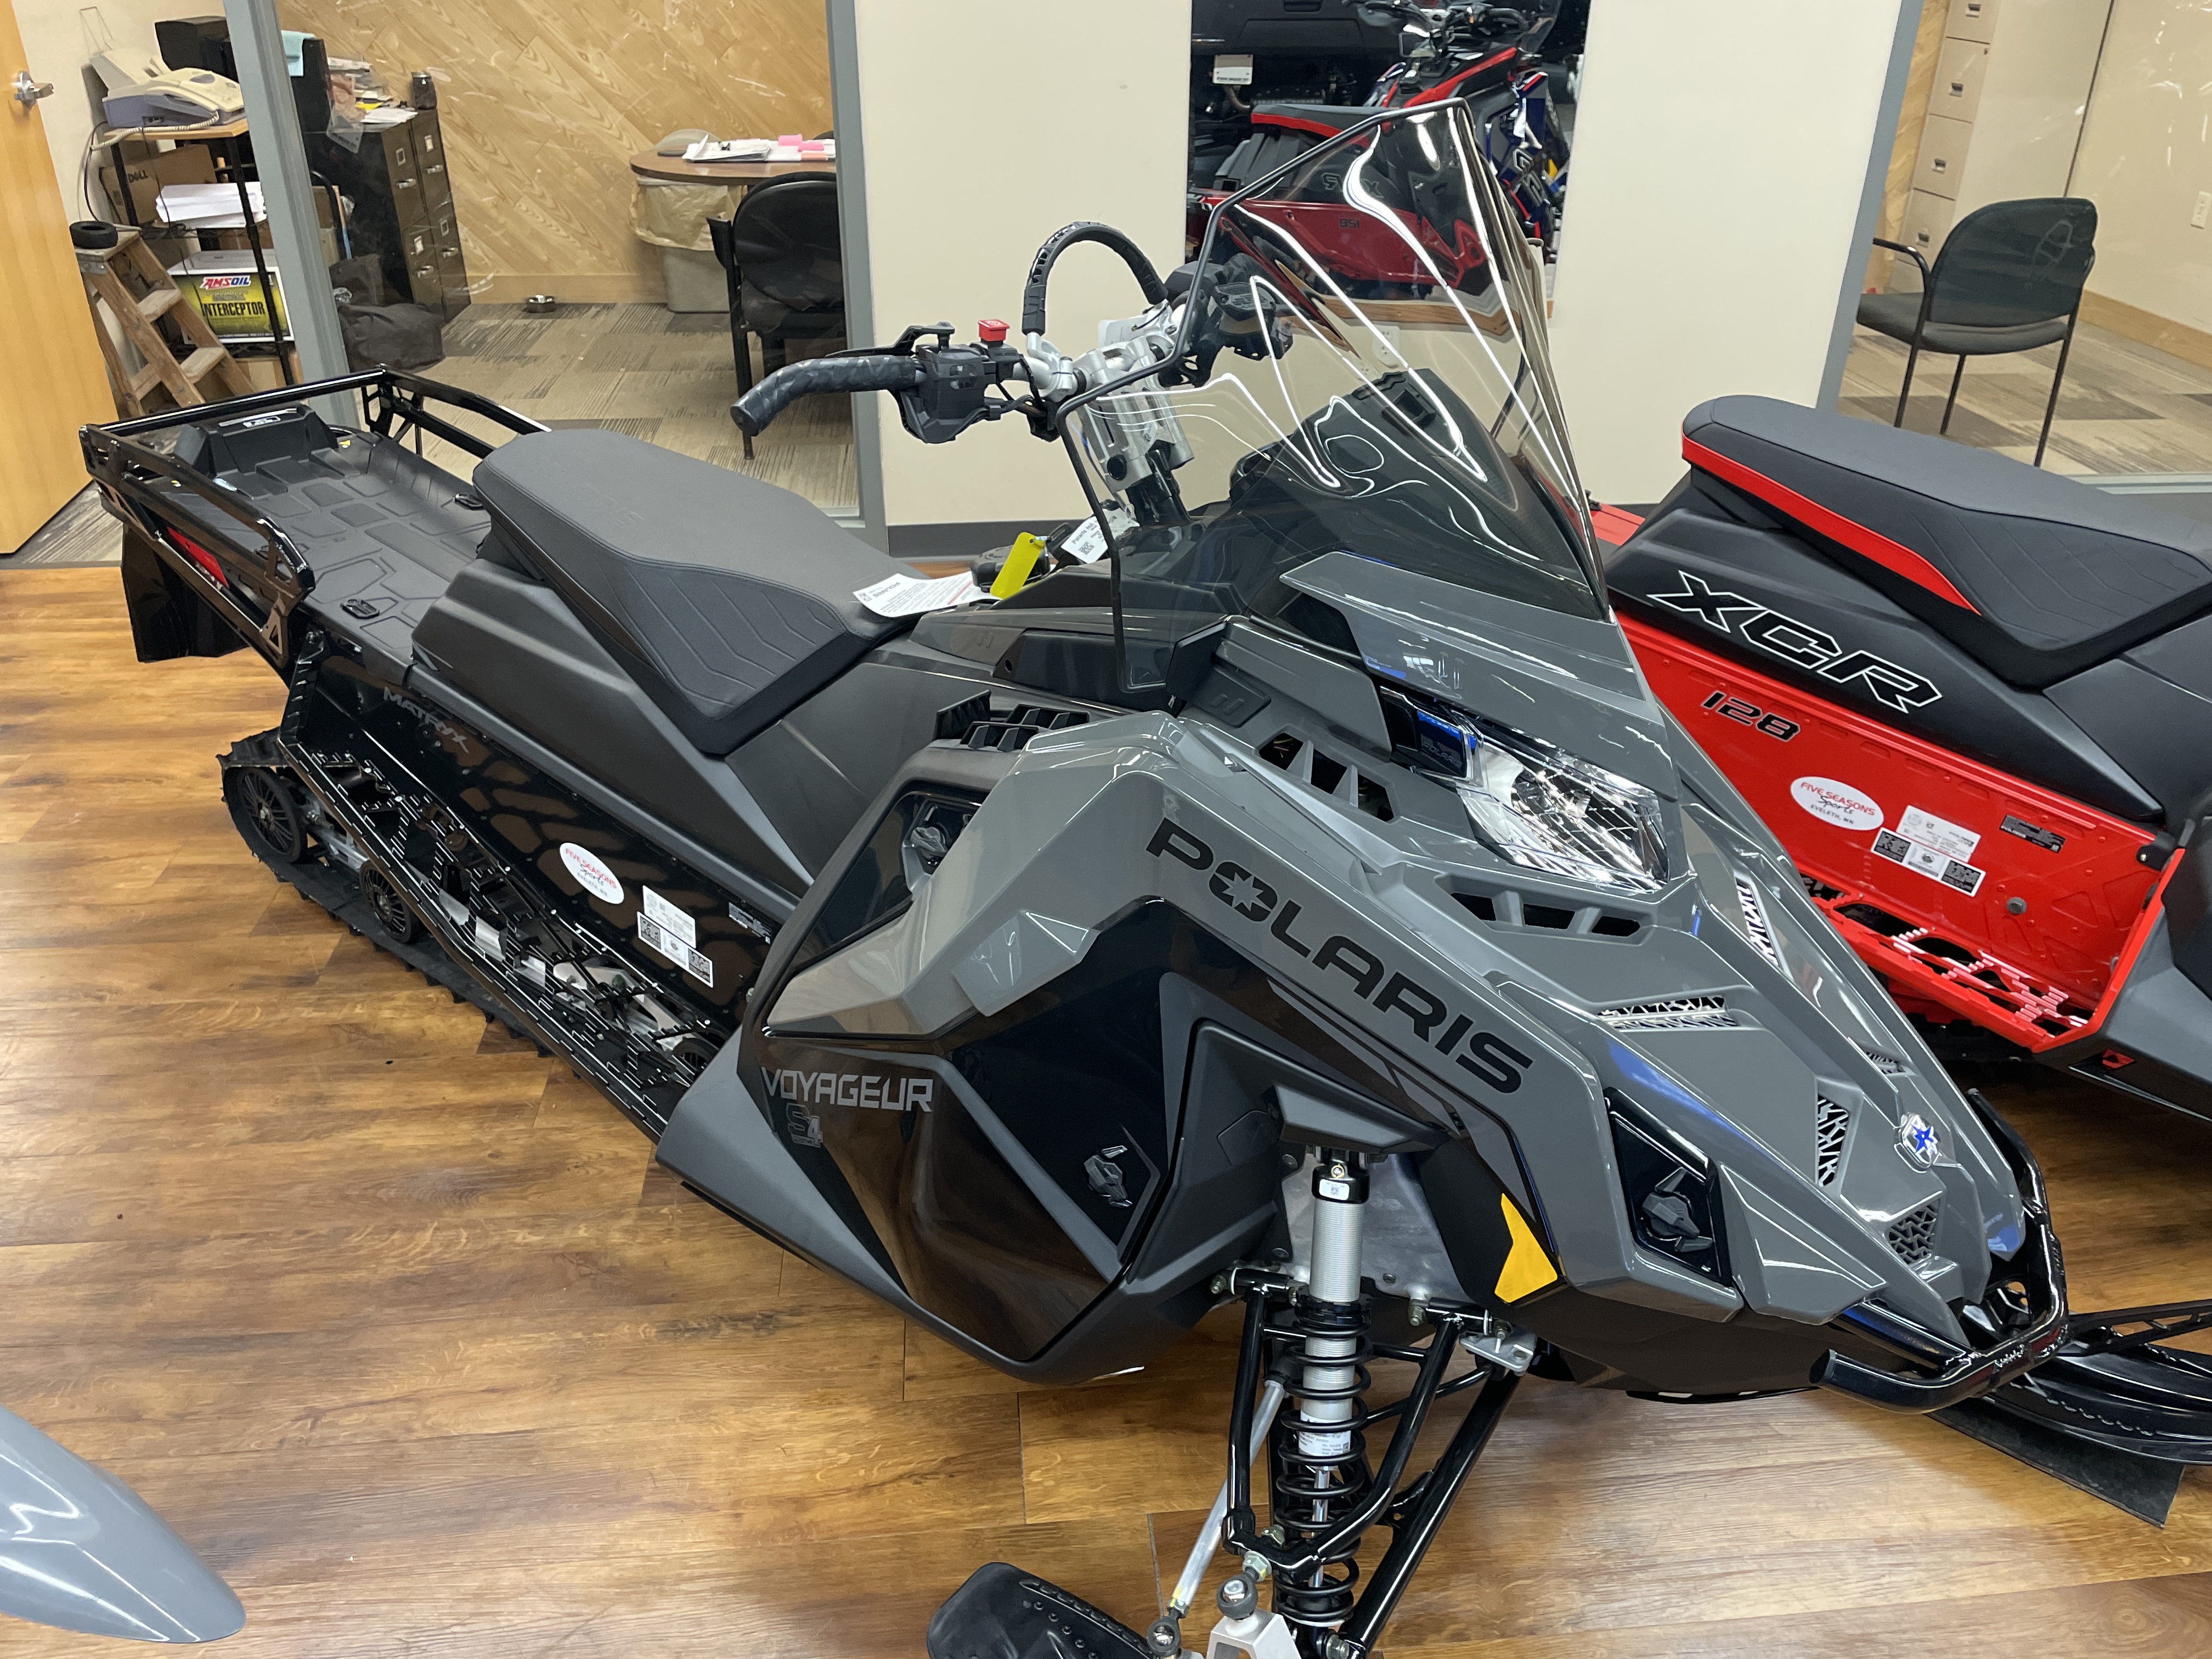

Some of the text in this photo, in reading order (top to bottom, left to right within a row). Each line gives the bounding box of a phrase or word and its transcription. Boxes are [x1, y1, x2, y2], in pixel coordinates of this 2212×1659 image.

[127, 170, 148, 183] DELL
[203, 277, 251, 289] AMSOIL
[202, 301, 266, 317] INTERCEPTOR
[1071, 529, 1088, 545] Polaris
[1646, 570, 1943, 713] XCR
[1702, 691, 1801, 742] 128
[1801, 782, 1876, 816] FIVE SEASONS
[1818, 795, 1855, 815] Sports
[566, 848, 617, 889] FIVE SEASONS
[580, 864, 604, 885] Sports
[1146, 817, 1534, 1094] POLARIS
[761, 1066, 933, 1112] VOYAGEUR
[786, 1103, 823, 1148] S4
